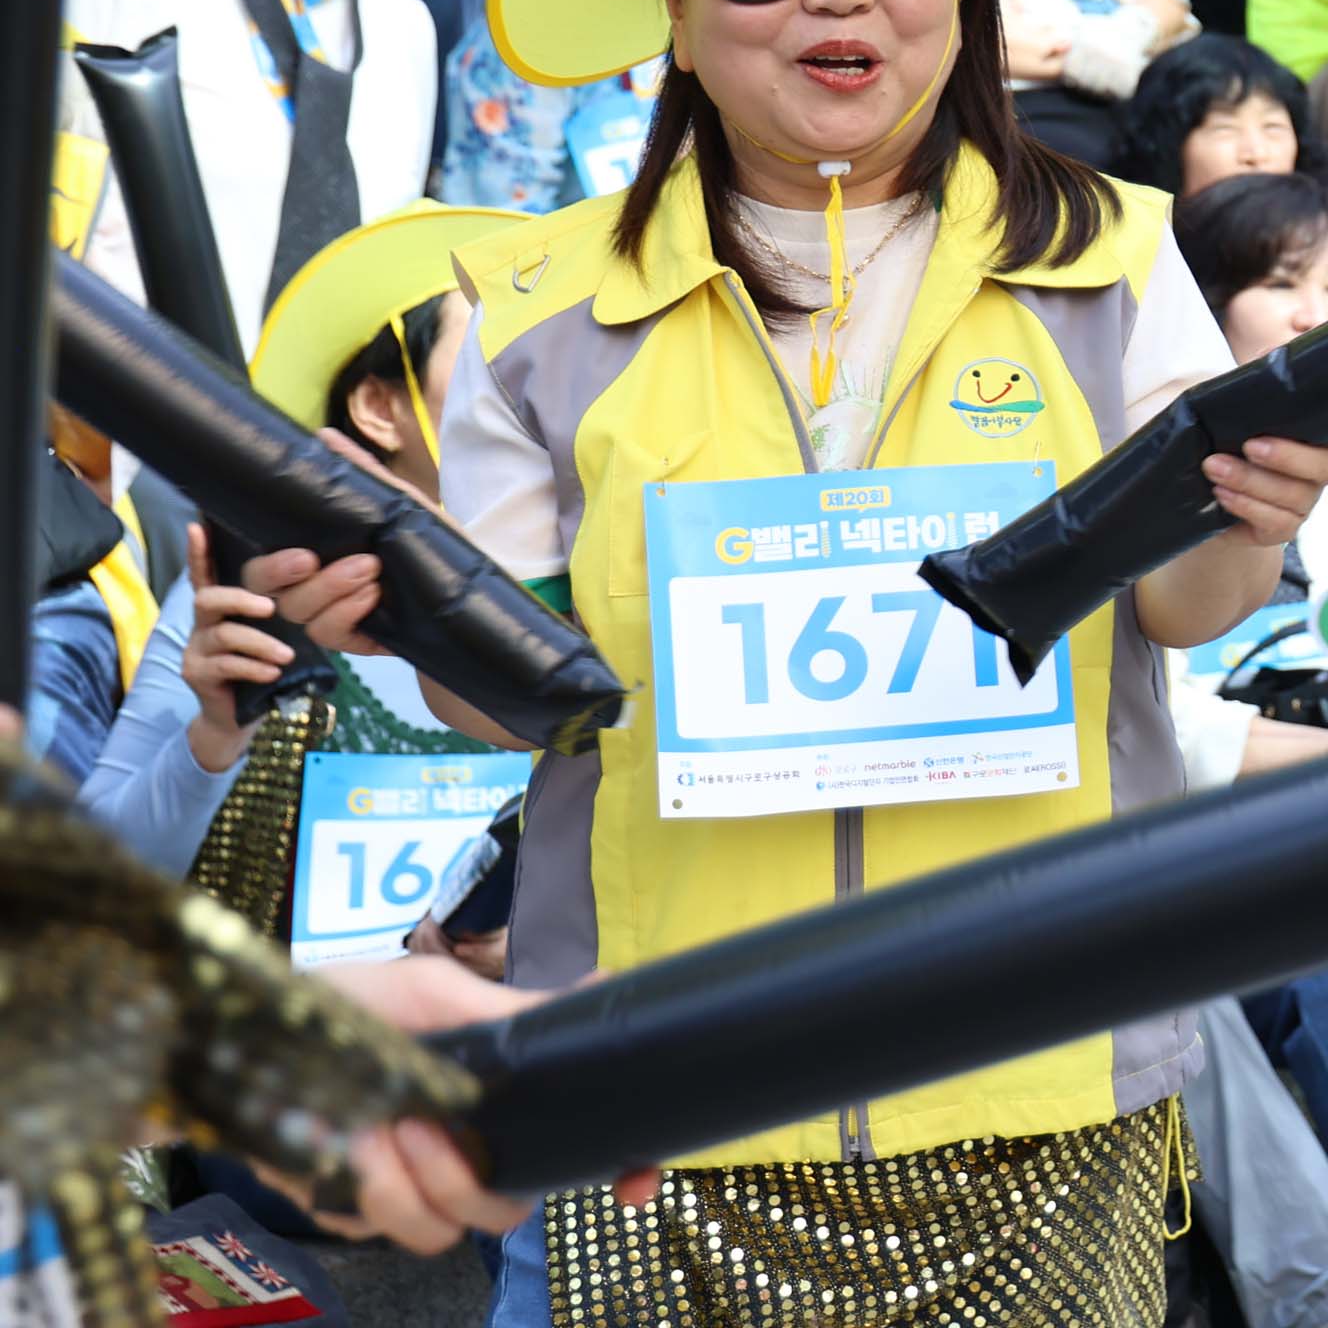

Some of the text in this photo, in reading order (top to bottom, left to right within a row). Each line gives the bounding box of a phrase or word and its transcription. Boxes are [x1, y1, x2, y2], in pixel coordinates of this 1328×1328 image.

[826, 488, 885, 508] 제20회
[714, 519, 832, 566] G밸리
[839, 510, 958, 554] 넥타이
[864, 760, 917, 772] netmarble
[927, 770, 957, 782] KIBA
[337, 839, 480, 912] 16
